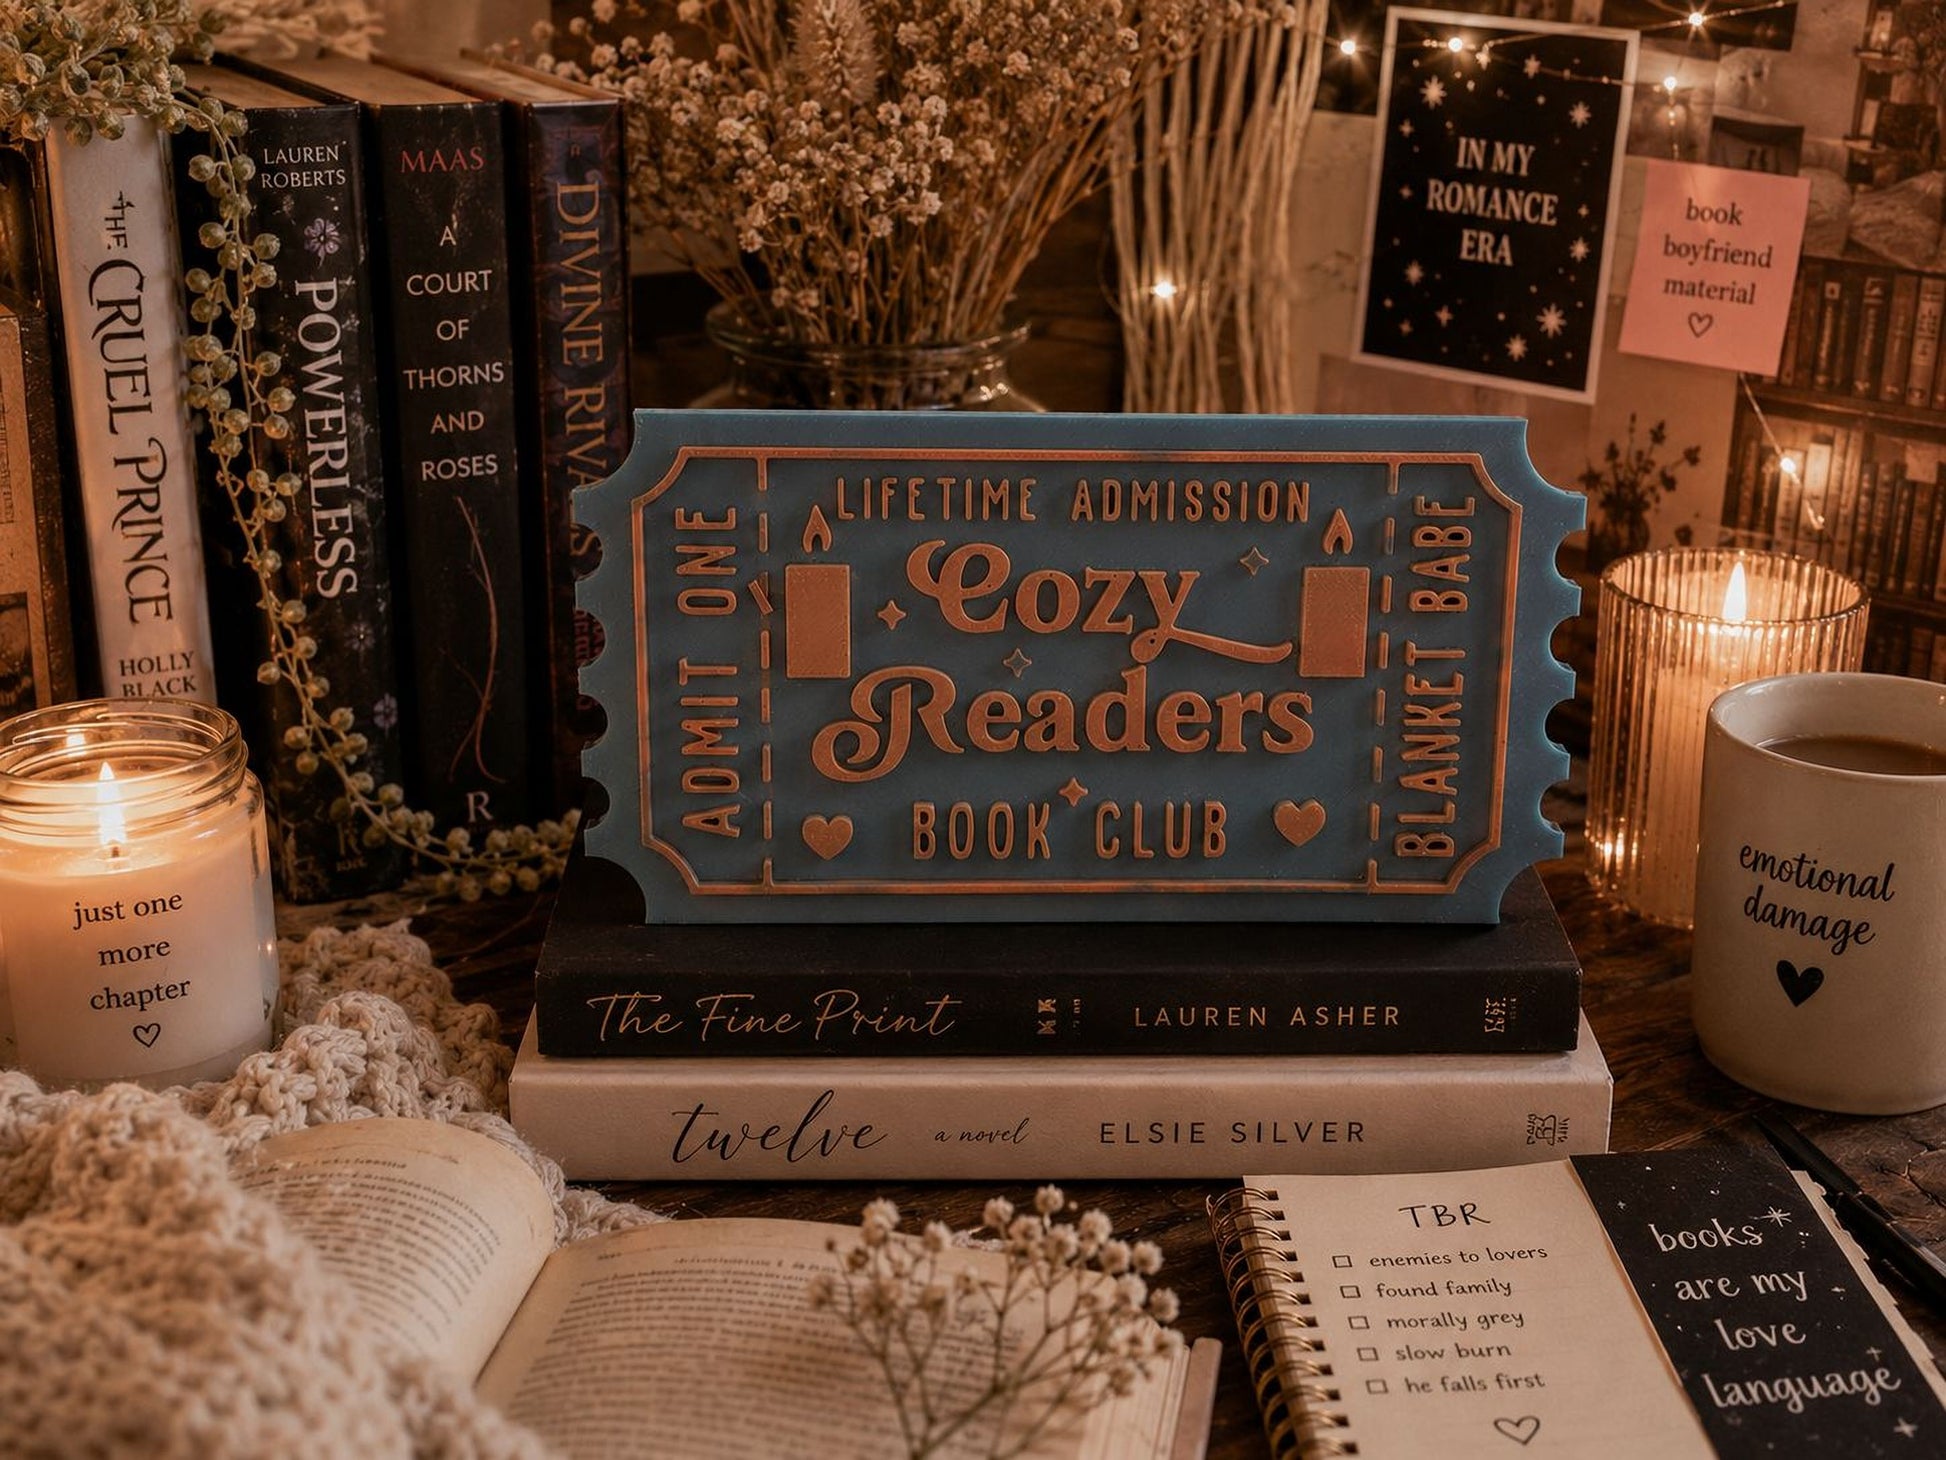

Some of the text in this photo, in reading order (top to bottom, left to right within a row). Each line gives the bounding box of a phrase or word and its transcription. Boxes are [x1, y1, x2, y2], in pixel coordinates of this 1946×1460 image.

[263, 145, 340, 165] LAUREN
[401, 147, 485, 173] MAAS
[1456, 136, 1536, 176] IN MY
[261, 169, 346, 189] ROBERTS
[1426, 178, 1559, 226] ROMANCE
[1686, 198, 1744, 226] book
[439, 226, 457, 247] A
[1459, 228, 1513, 267] ERA
[1662, 234, 1773, 269] boyfriend
[406, 269, 492, 295] COURT
[557, 181, 604, 366] DIVINE
[1662, 278, 1756, 305] material
[436, 319, 470, 341] OF
[403, 362, 505, 390] THORNS
[88, 191, 173, 624] THE CRUEL PRINCE
[430, 410, 484, 434] AND
[295, 277, 358, 598] POWERLESS
[421, 454, 499, 481] ROSES
[564, 385, 607, 557] RIVAS
[836, 477, 1311, 523] LIFETIME ADMISSION
[906, 539, 1294, 664] Cozy
[118, 651, 194, 677] HOLLY
[675, 506, 741, 838] ADMIT ONE
[1393, 495, 1476, 857] BLANKET BABE
[122, 675, 196, 698] BLACK
[811, 664, 1315, 782] Readers
[913, 800, 1228, 860] BOOK CLUB
[1739, 845, 1895, 901] emotional
[73, 894, 183, 930] just one
[1743, 885, 1876, 955] damage
[98, 940, 171, 966] more
[90, 980, 191, 1012] chapter
[587, 990, 683, 1042] The
[695, 993, 801, 1042] Fine
[812, 988, 963, 1041] Print
[1134, 1007, 1267, 1027] LAUREN
[1290, 1006, 1400, 1027] ASHER
[671, 1089, 1366, 1163] twelve a novel ELSIE SILVER
[1398, 1202, 1491, 1228] TBR
[1648, 1218, 1763, 1252] books
[1369, 1247, 1548, 1267] enemies to lovers
[1376, 1278, 1513, 1298] found family
[1674, 1271, 1808, 1302] are my
[1387, 1312, 1525, 1331] morally grey
[1714, 1319, 1807, 1351] love
[1395, 1343, 1512, 1361] slow burn
[1405, 1373, 1546, 1394] he falls first
[1703, 1367, 1901, 1414] language
